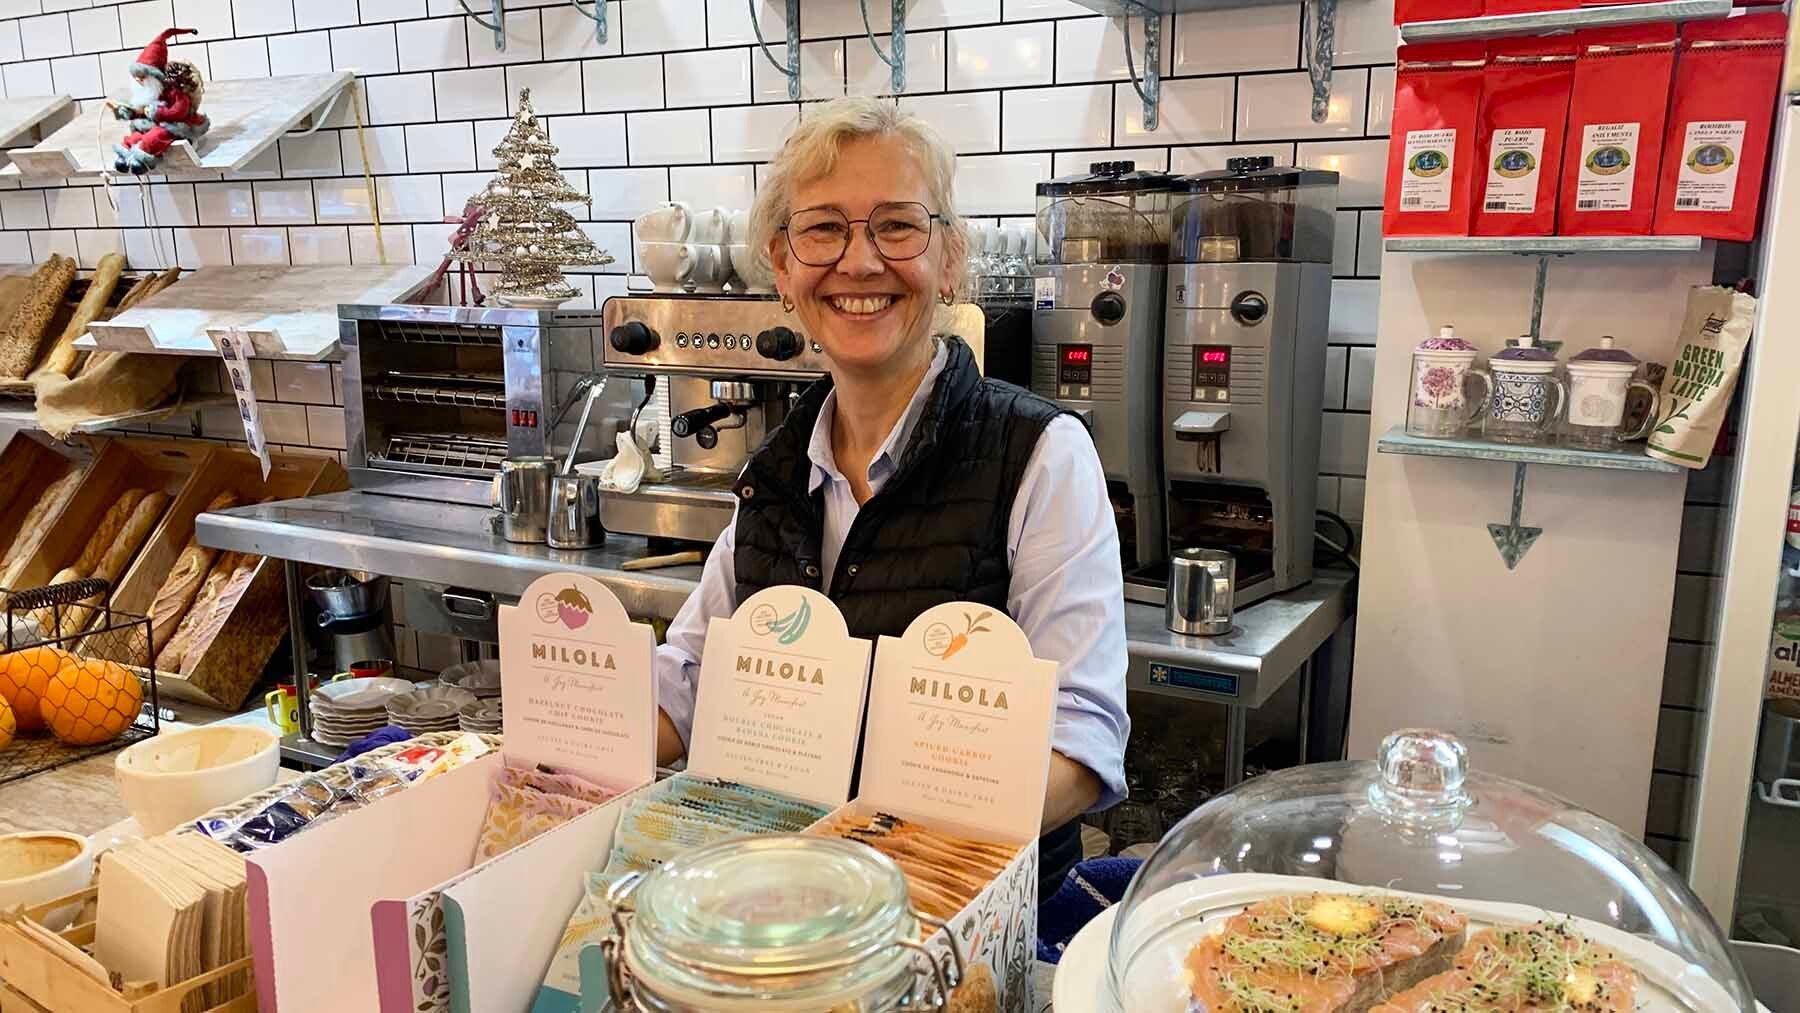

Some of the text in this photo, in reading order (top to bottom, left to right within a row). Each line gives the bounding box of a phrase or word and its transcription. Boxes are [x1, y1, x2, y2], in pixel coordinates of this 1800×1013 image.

[1682, 344, 1724, 369] GREEN
[1672, 360, 1725, 388] MATCHA
[1670, 380, 1709, 402] LATTE
[532, 643, 617, 670] MILOLA
[736, 655, 824, 686] MILOLA
[910, 676, 1009, 710] MILOLA
